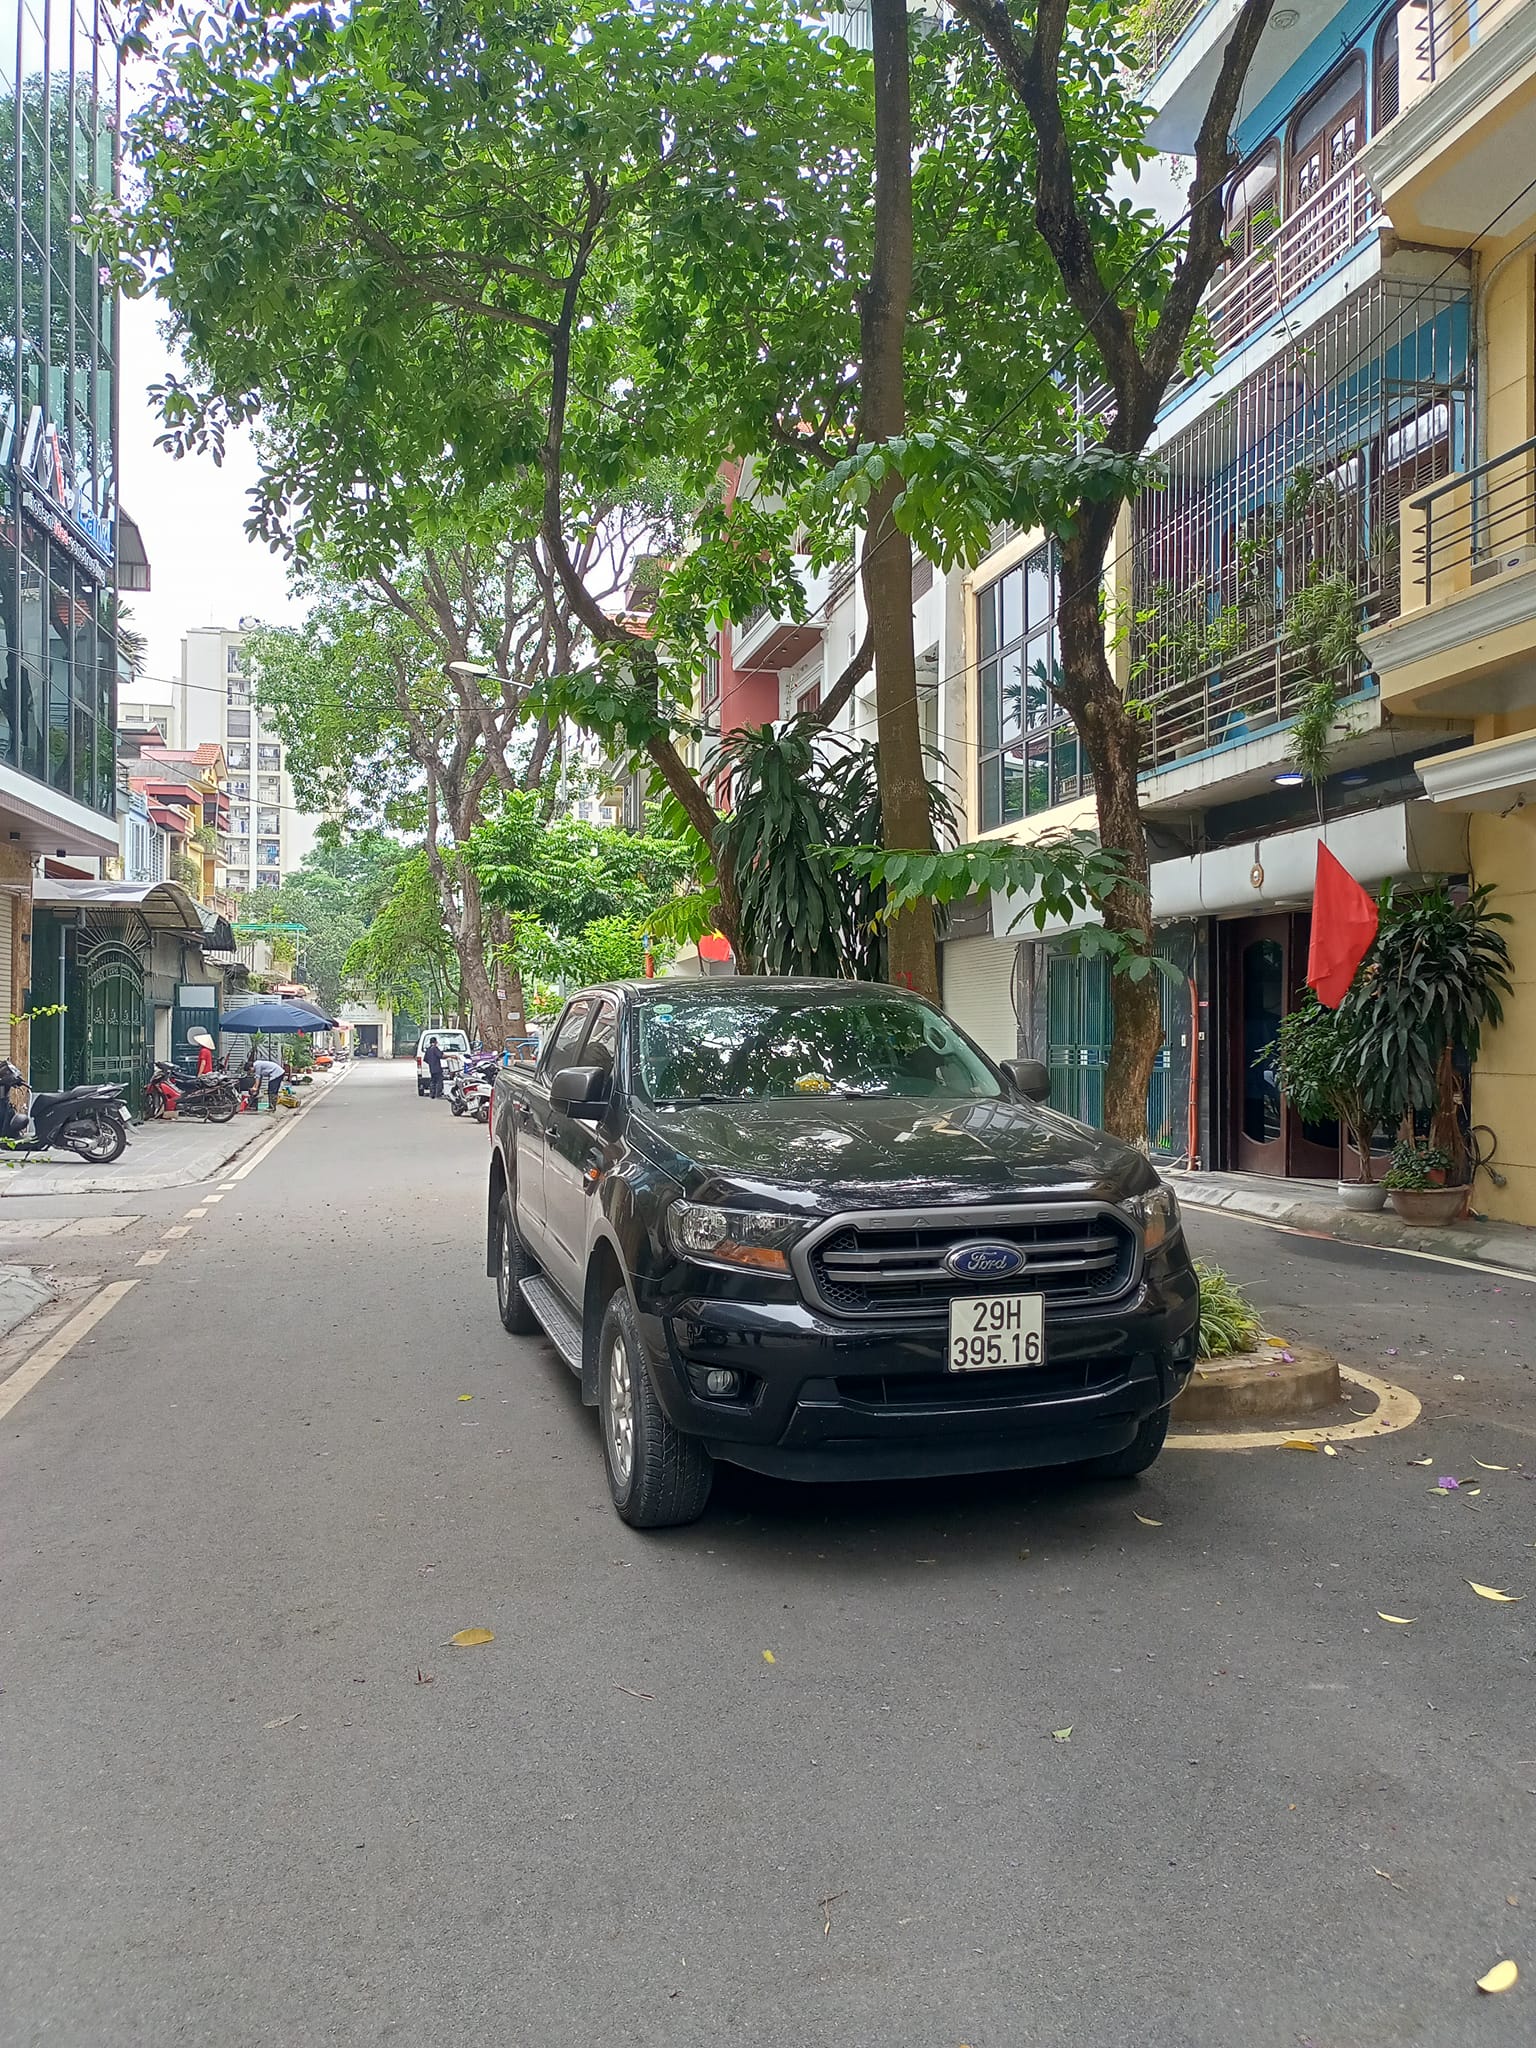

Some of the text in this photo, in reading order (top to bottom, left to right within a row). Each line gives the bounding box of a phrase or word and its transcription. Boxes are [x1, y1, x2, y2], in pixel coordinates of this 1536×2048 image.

[966, 1251, 1009, 1271] Ford
[972, 1299, 1022, 1332] 29H
[952, 1332, 1041, 1367] 395.16
